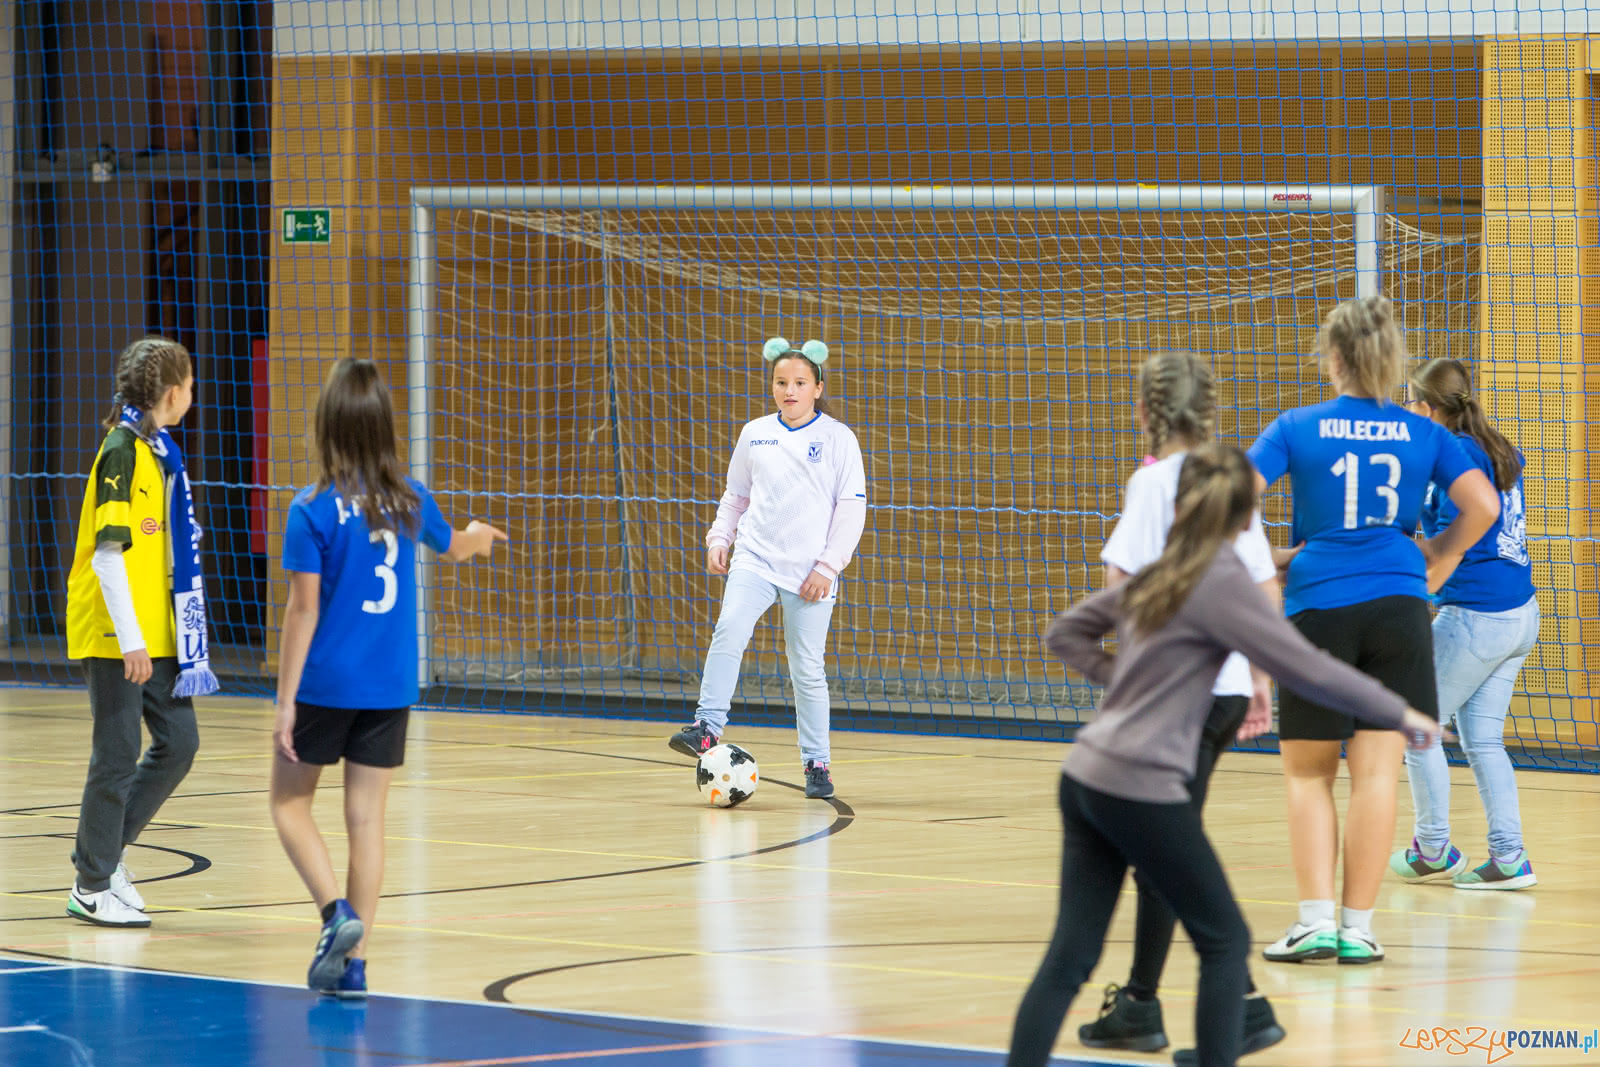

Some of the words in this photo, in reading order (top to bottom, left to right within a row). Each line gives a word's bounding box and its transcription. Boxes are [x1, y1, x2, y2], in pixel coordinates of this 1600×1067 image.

[750, 438, 779, 447] macron
[1319, 418, 1411, 442] KULECZKA
[1330, 451, 1402, 530] 13
[361, 528, 399, 614] 3
